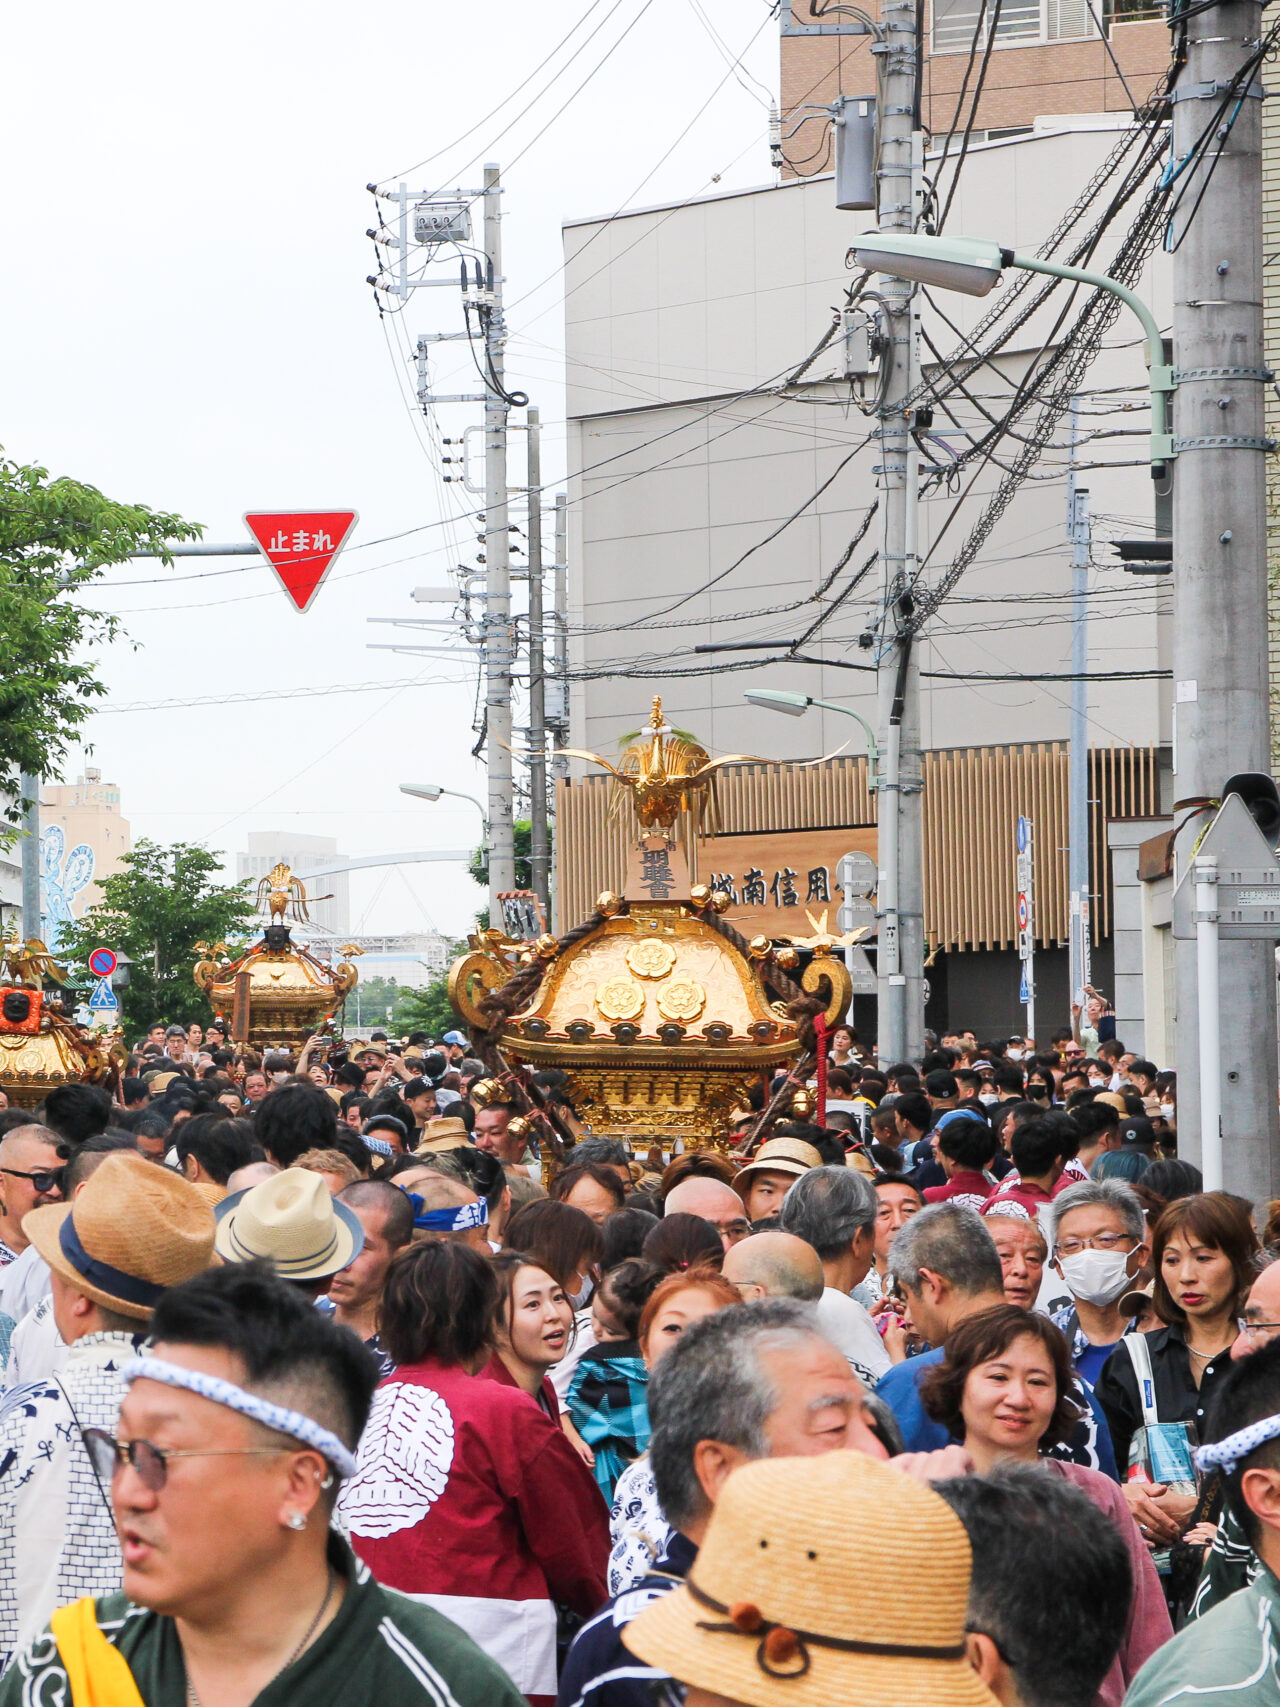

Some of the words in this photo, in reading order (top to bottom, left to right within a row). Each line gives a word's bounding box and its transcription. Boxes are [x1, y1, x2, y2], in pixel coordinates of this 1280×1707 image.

[267, 529, 335, 553] 止まれ
[708, 866, 878, 908] 城南信用
